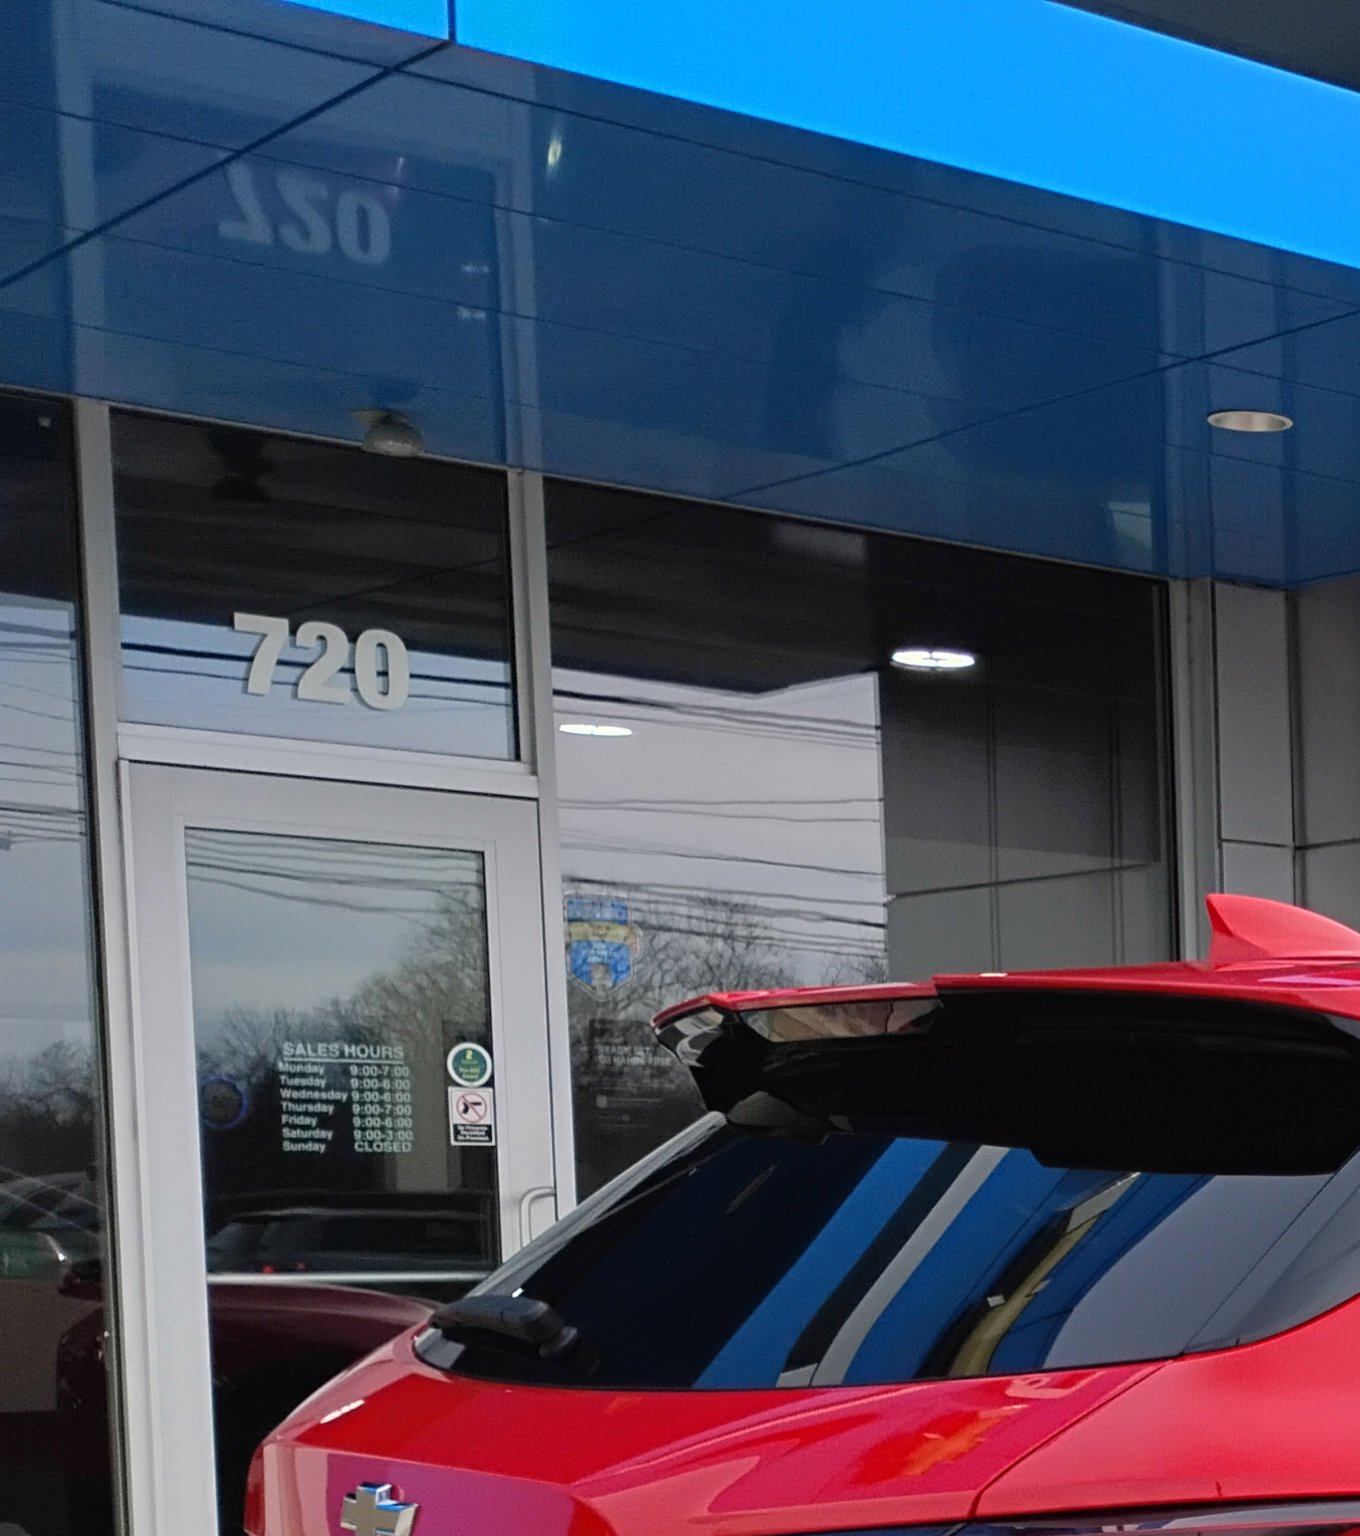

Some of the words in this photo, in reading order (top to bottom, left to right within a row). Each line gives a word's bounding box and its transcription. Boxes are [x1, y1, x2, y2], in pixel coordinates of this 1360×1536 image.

[233, 612, 410, 711] 720
[283, 1042, 340, 1058] SALES
[344, 1044, 404, 1059] HOURS
[278, 1061, 325, 1075] Monday
[279, 1075, 326, 1089] Tuesday
[280, 1088, 348, 1102] Wednesday
[281, 1101, 335, 1115] Thursday
[281, 1114, 318, 1127] Friday
[282, 1127, 334, 1140] Saturday
[282, 1140, 326, 1154] Sunday
[354, 1141, 412, 1153] CLOSED
